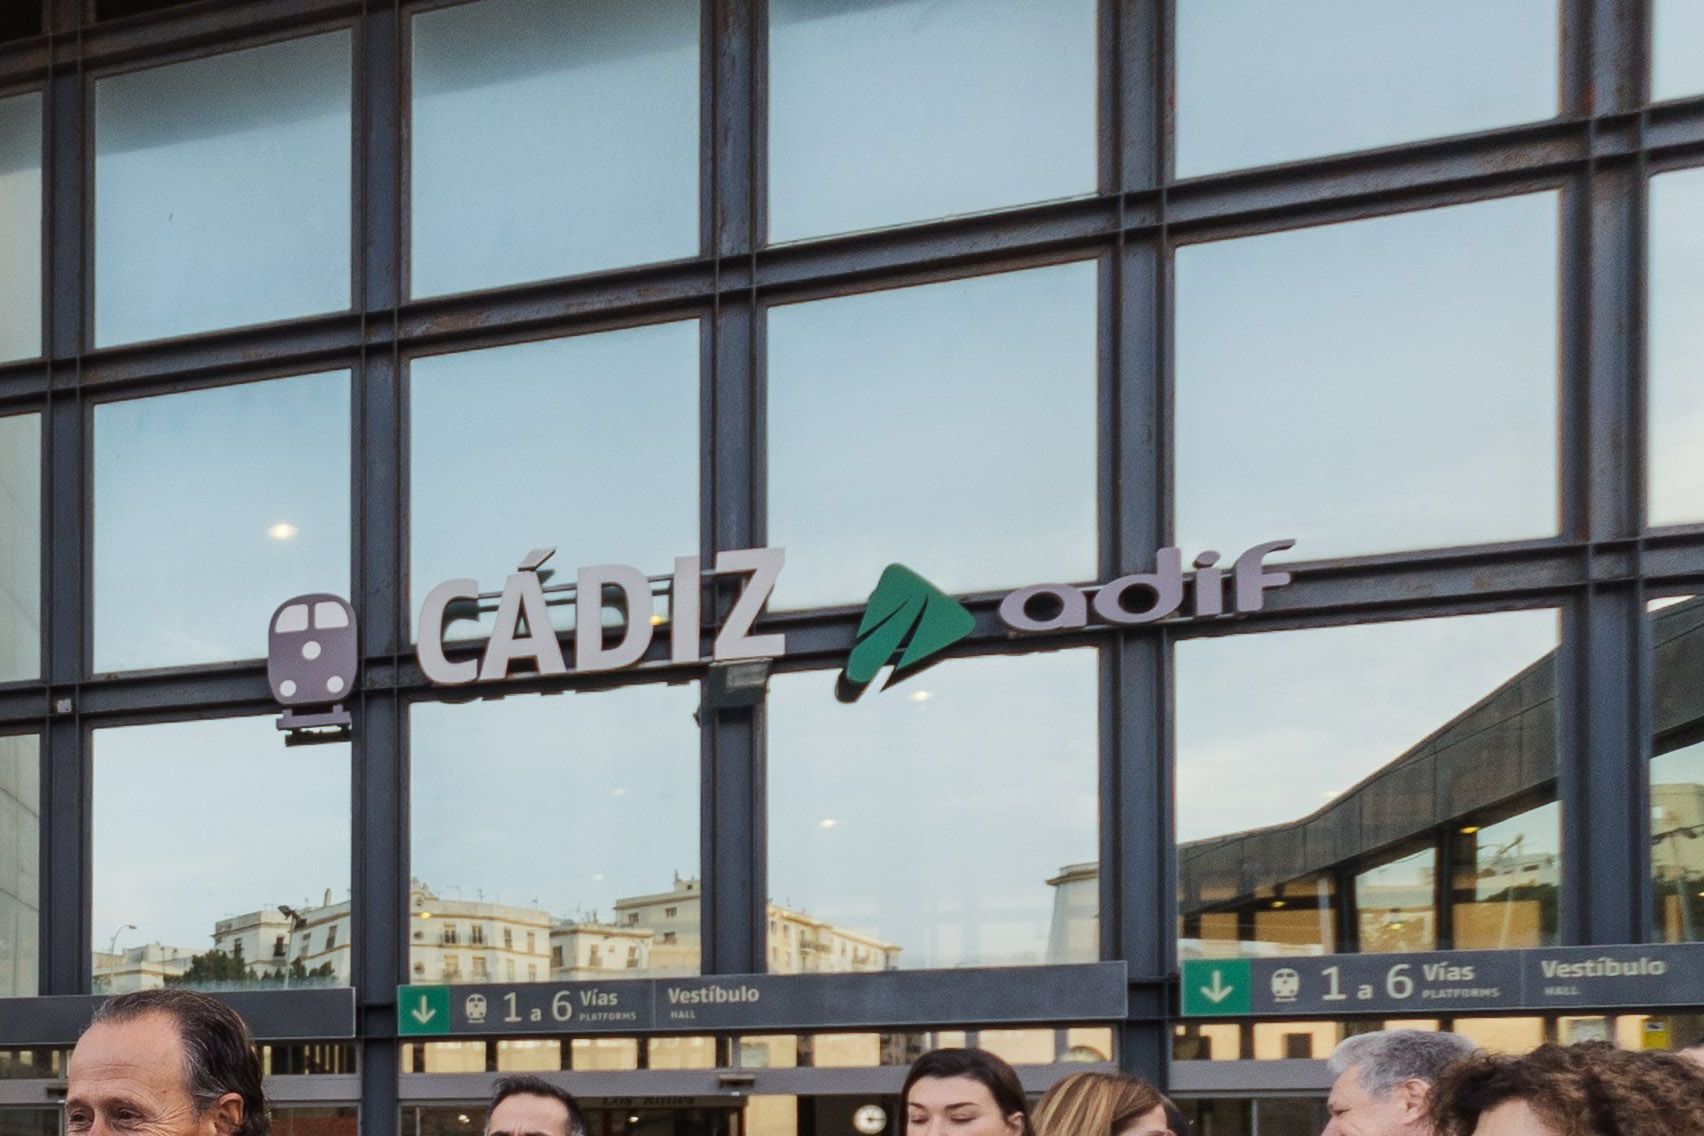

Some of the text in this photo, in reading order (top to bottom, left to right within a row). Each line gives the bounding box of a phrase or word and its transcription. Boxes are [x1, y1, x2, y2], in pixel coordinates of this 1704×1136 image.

[999, 538, 1296, 632] adif
[417, 546, 786, 684] CÁDIZ
[1541, 957, 1667, 978] Vestíbulo
[1321, 961, 1475, 1001] 1 a 6 Vías
[1545, 985, 1579, 997] HALL
[668, 985, 760, 1004] Vestíbulo
[1421, 986, 1500, 999] PLATFORMS
[503, 989, 618, 1023] 1 a 6 Vías
[670, 1010, 696, 1020] HALL
[579, 1011, 637, 1022] PLATFORMS
